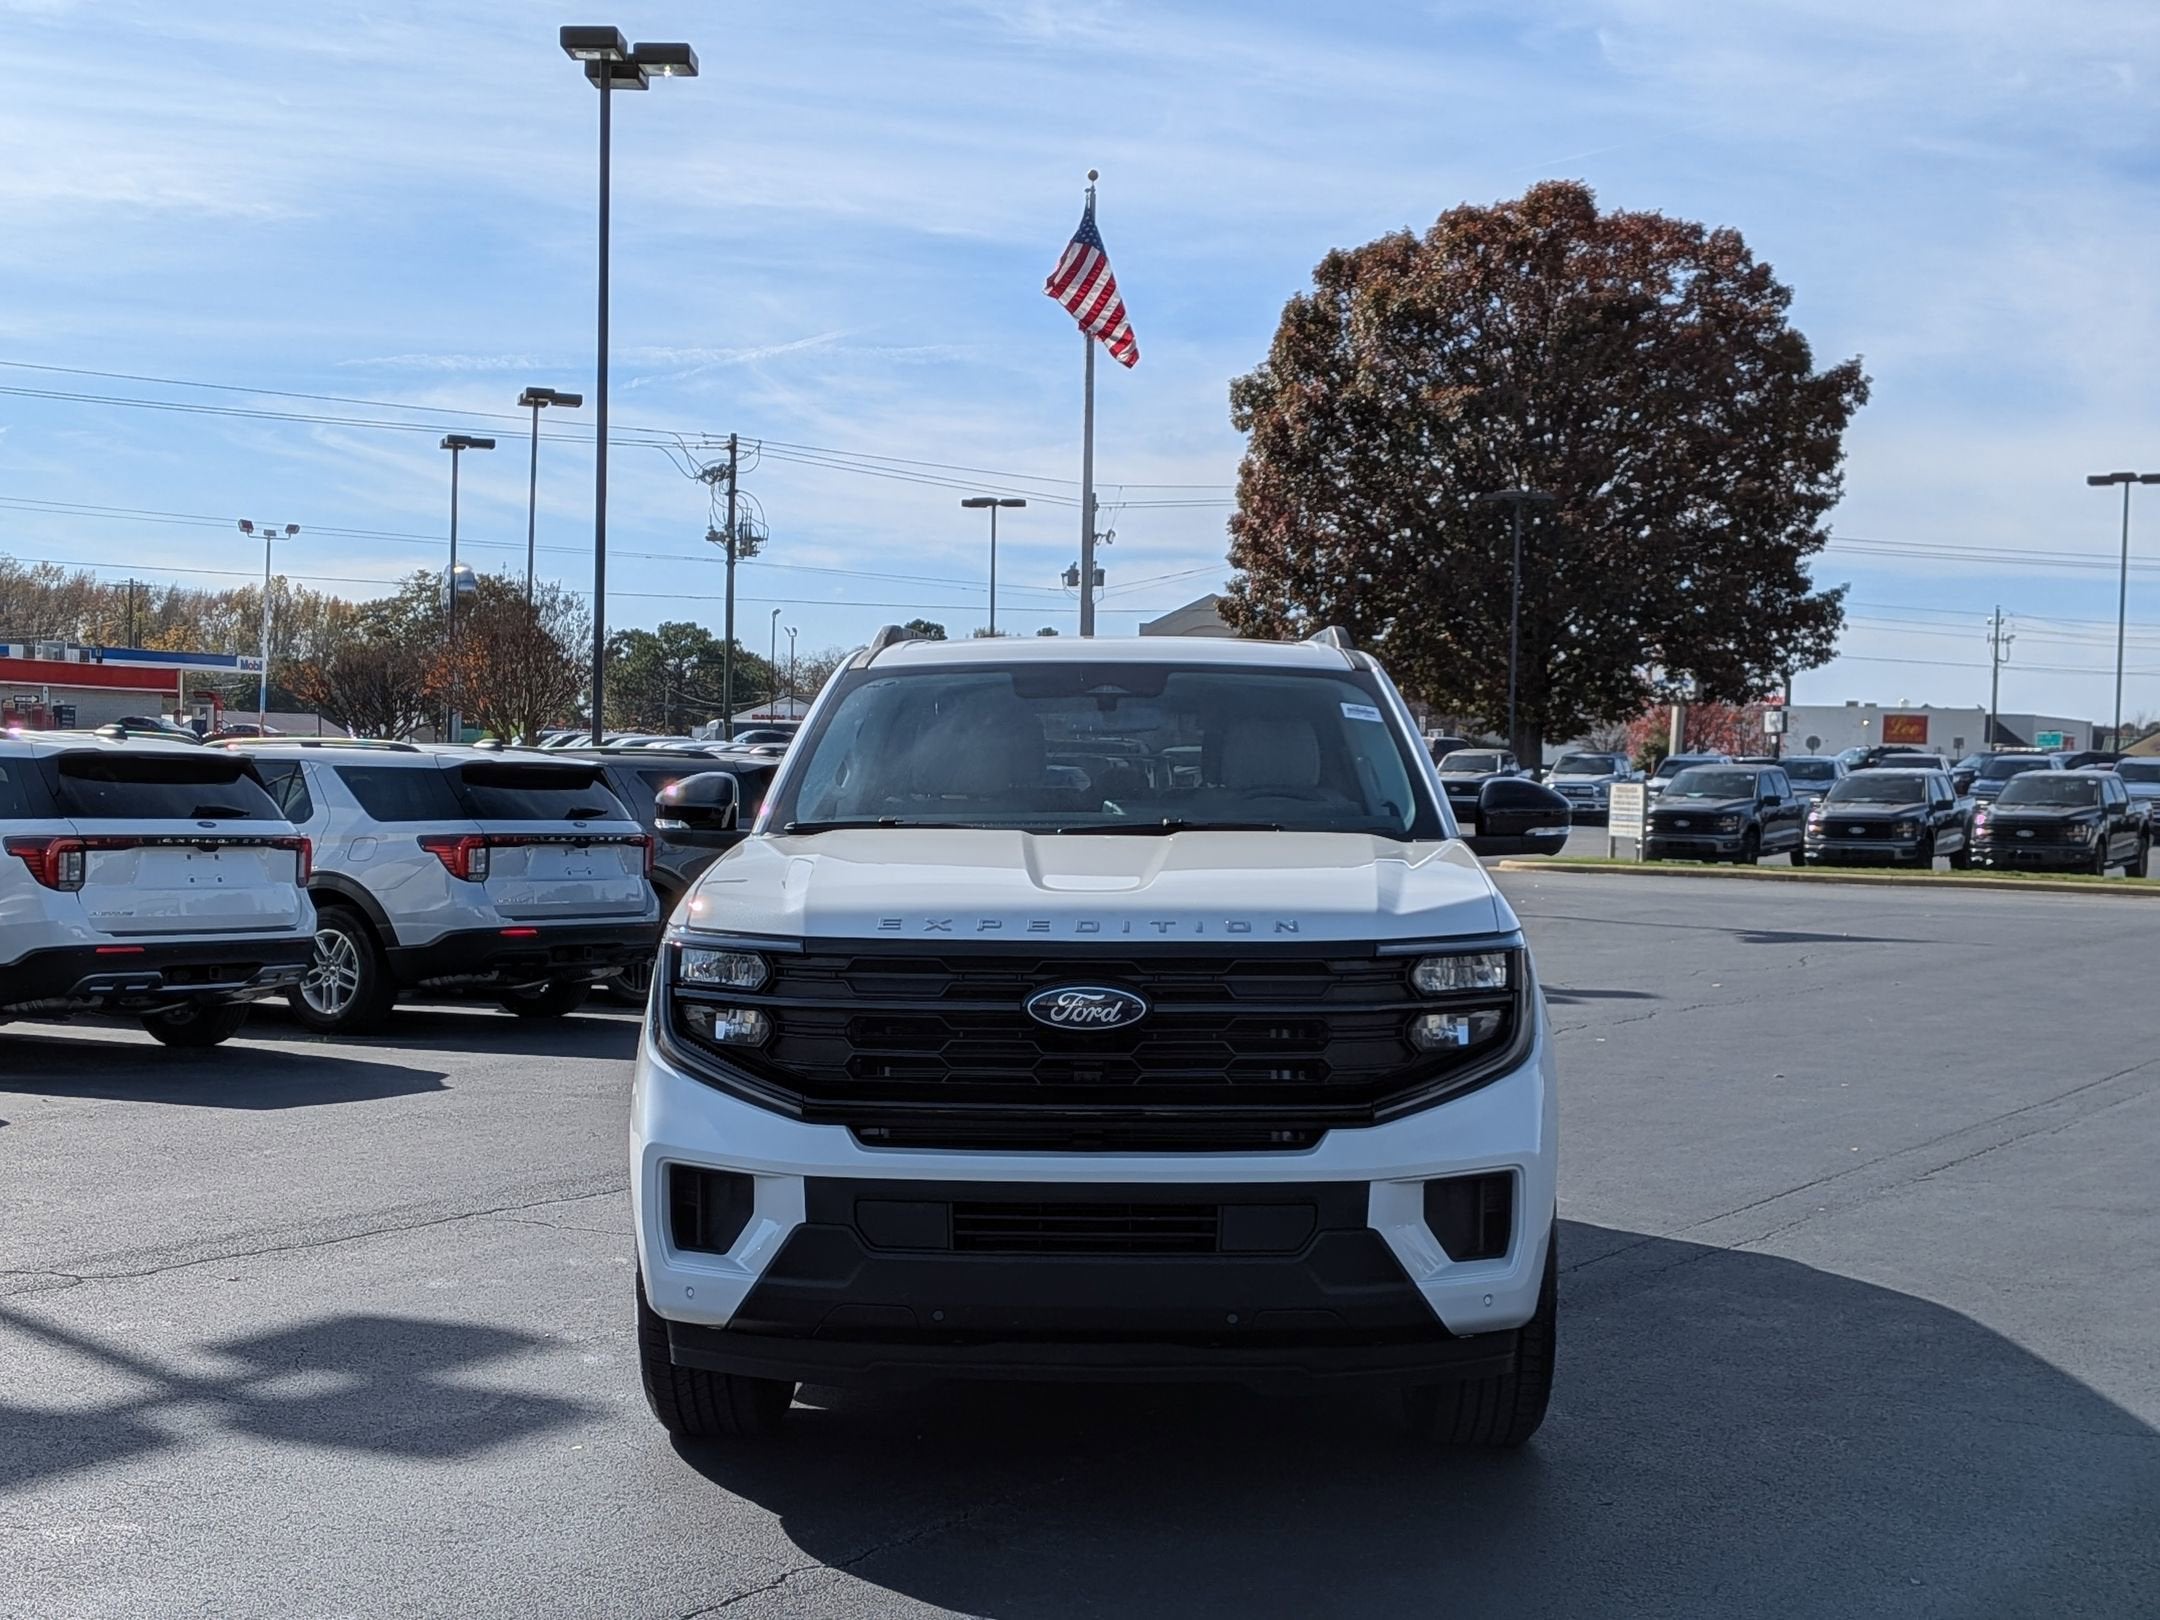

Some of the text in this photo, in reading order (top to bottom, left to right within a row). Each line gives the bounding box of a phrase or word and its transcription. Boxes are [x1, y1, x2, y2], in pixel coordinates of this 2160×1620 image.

[240, 659, 263, 671] Mobi
[877, 917, 1300, 934] EXPEDITION
[1050, 991, 1122, 1023] Ford
